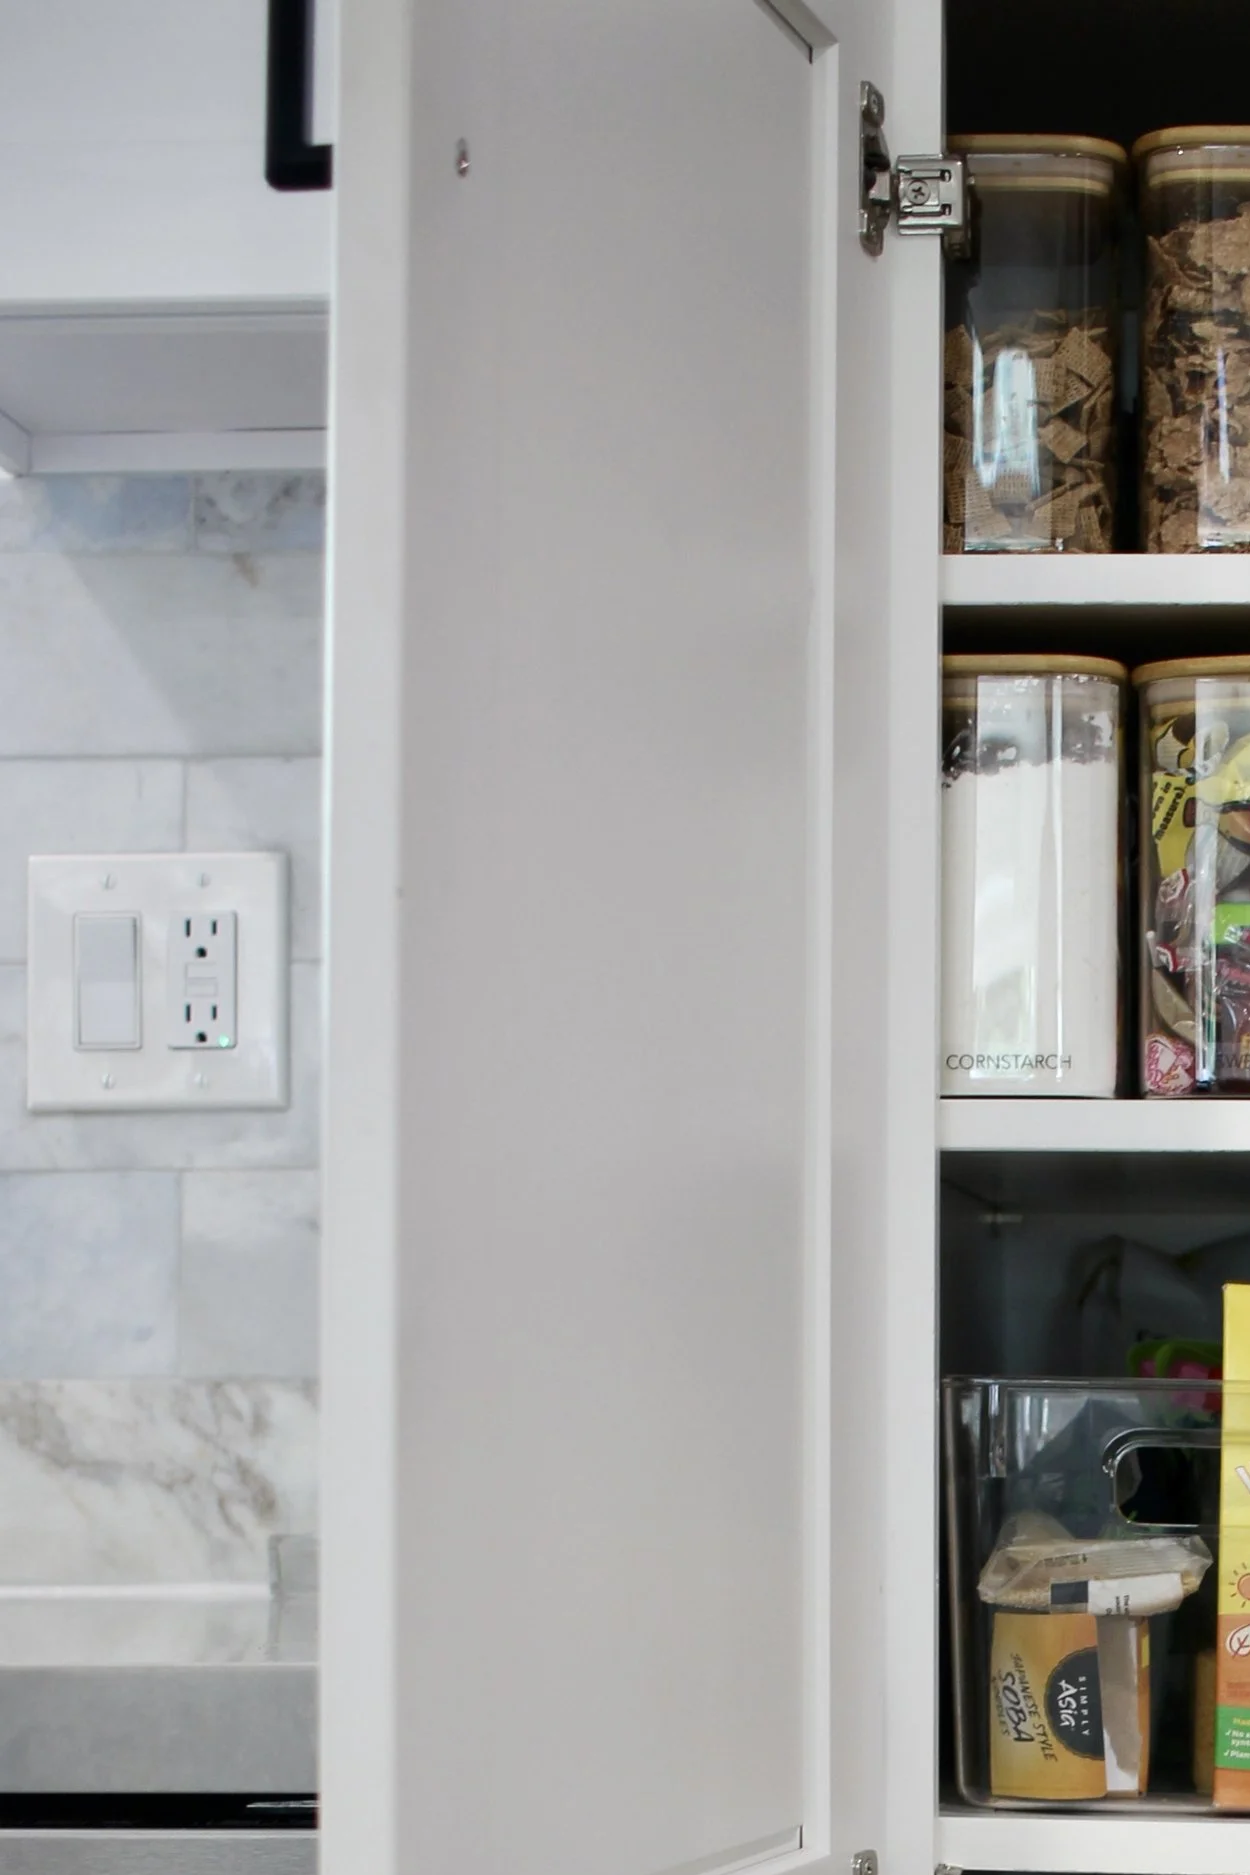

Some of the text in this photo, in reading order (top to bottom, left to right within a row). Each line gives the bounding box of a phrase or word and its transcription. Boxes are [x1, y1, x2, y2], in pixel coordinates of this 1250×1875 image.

[945, 1053, 1073, 1070] CORNSTARCH
[1001, 1671, 1035, 1742] SOBA
[1057, 1679, 1078, 1728] Asia
[1078, 1676, 1090, 1736] SIMPLY
[1032, 1722, 1059, 1763] STYLE
[1231, 1729, 1245, 1738] No
